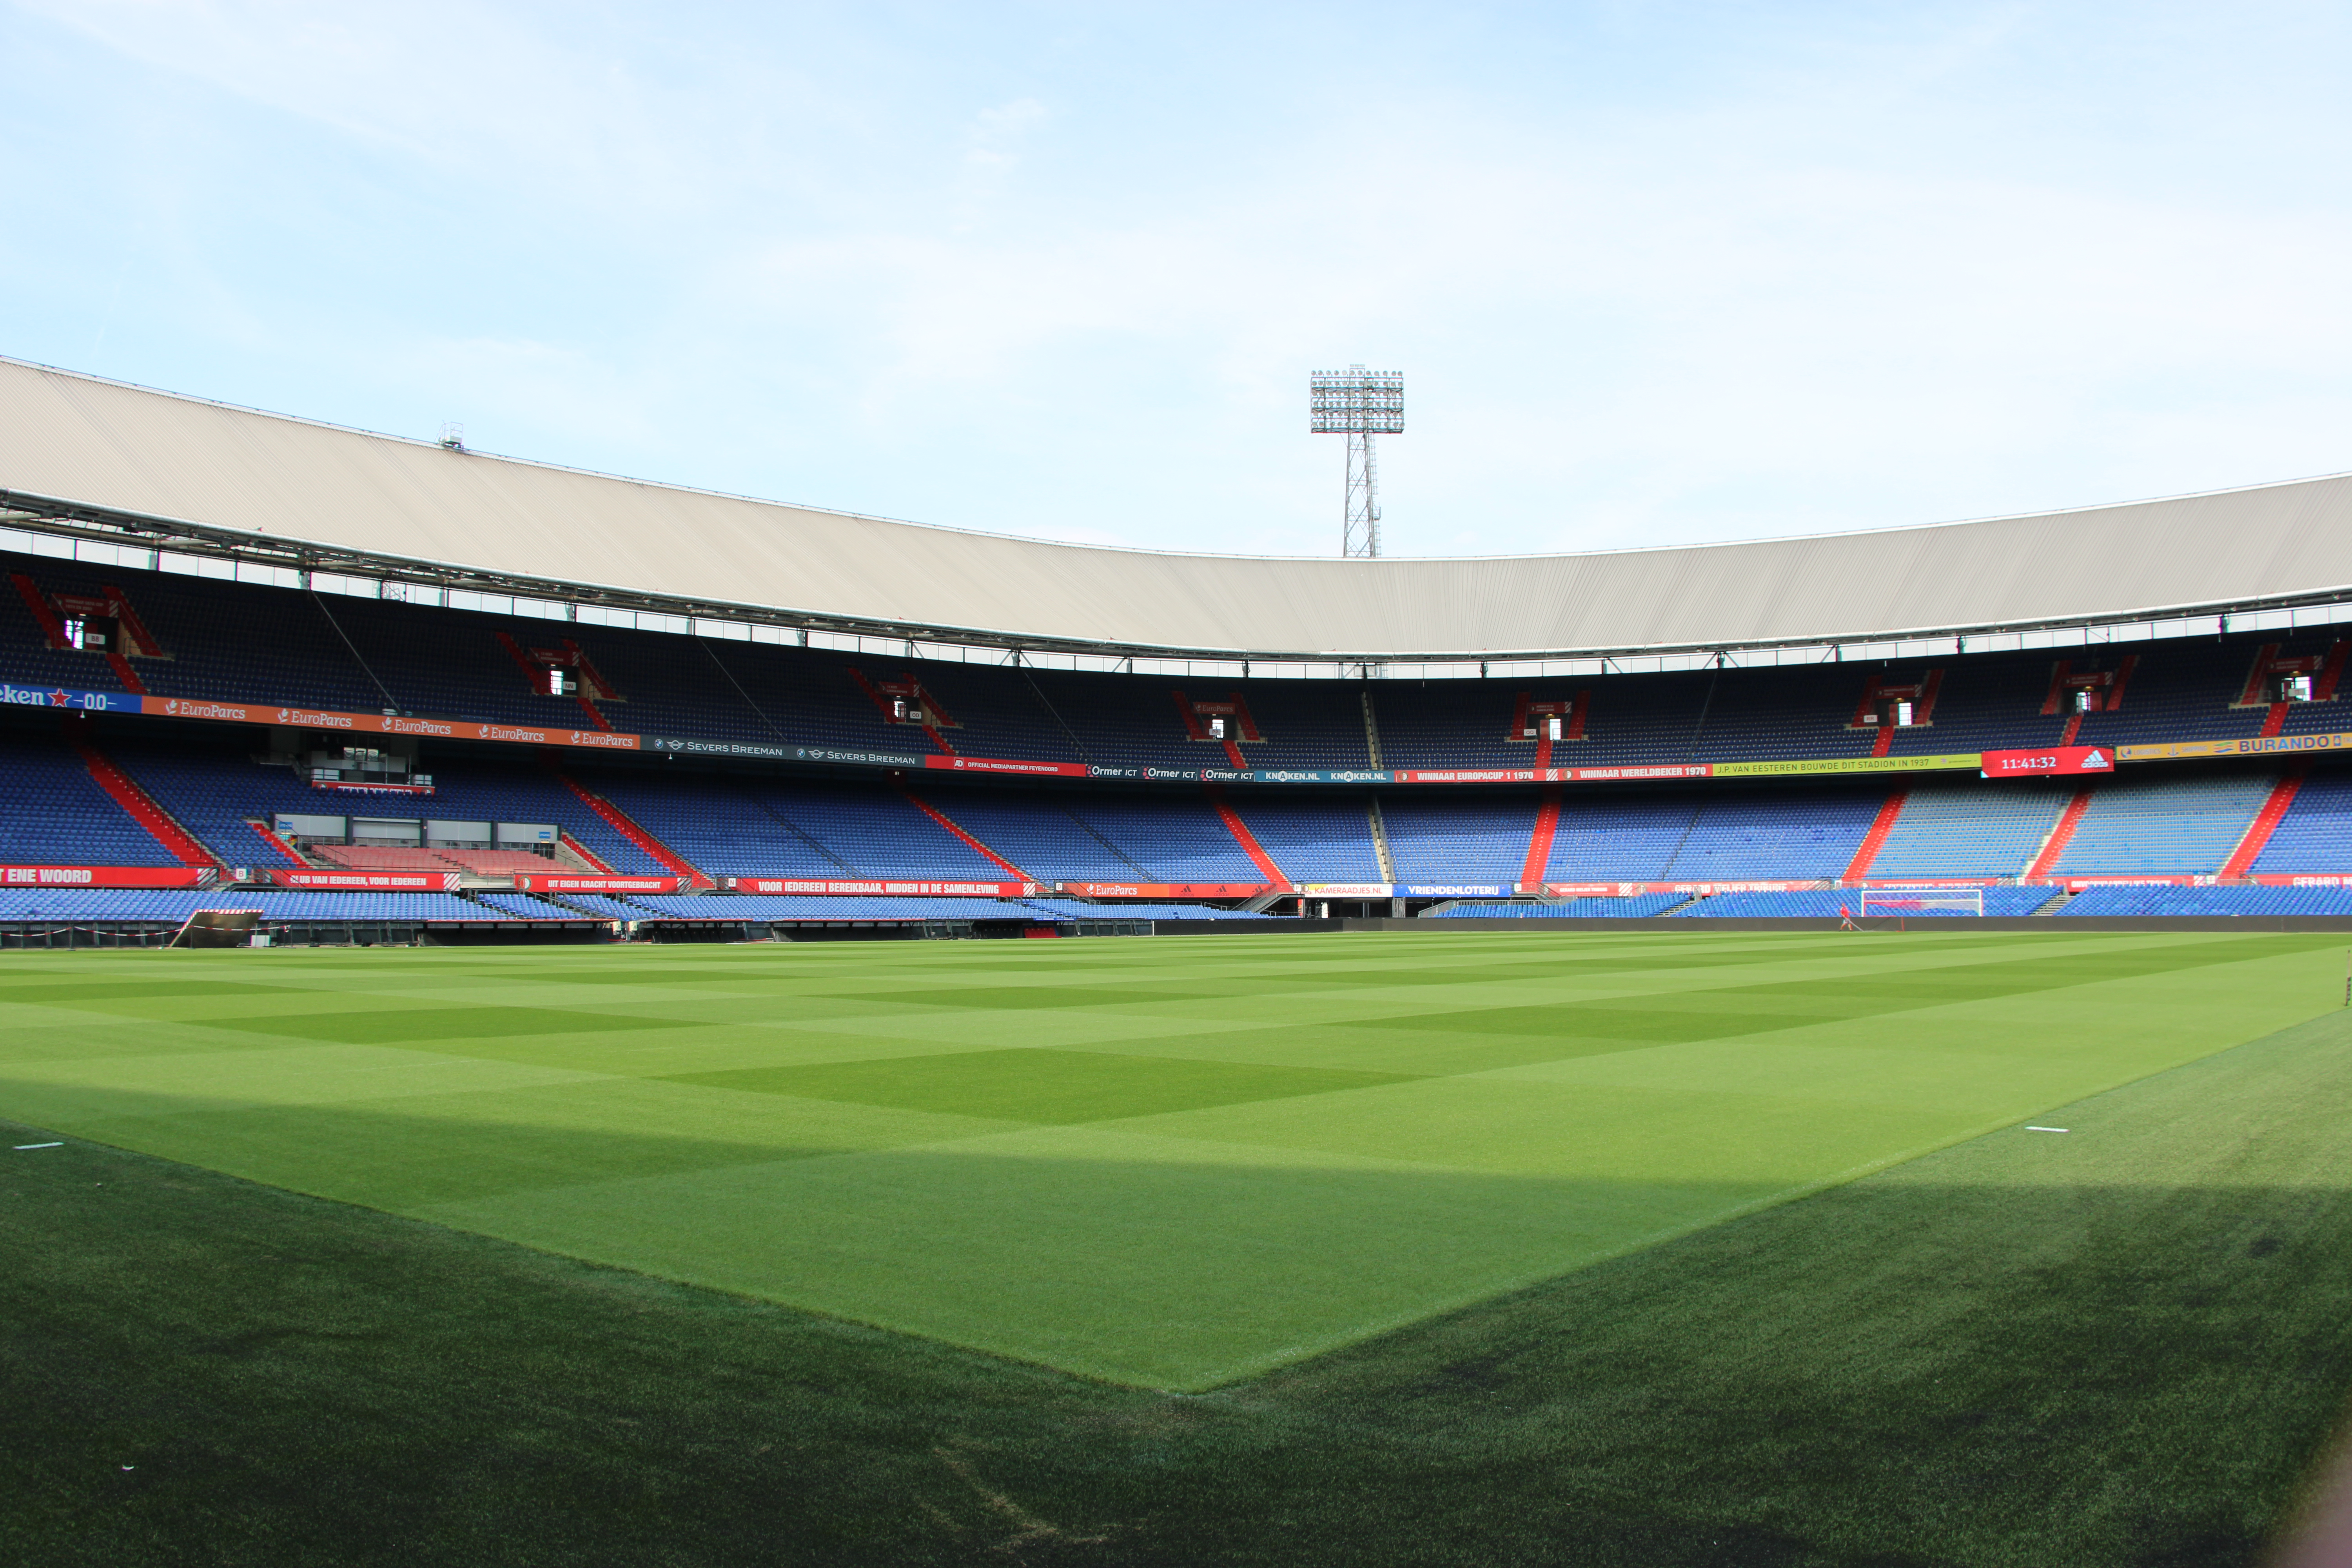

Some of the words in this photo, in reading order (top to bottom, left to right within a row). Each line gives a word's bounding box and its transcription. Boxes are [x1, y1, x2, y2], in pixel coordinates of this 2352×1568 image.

[180, 701, 245, 720] EuroParcs
[292, 711, 352, 728] EuroParcs
[394, 719, 451, 735] EuroParcs
[491, 727, 544, 742] EuroParcs
[583, 733, 633, 747] EuroParcs
[687, 742, 729, 752] SEVERS
[731, 745, 782, 756] BREEMAN
[2239, 735, 2329, 752] BURANDO
[827, 751, 866, 761] SEVERS
[869, 754, 915, 764] BREEMAN
[2002, 757, 2057, 769] 11:41:32
[1092, 766, 1122, 776] Ormer
[1801, 762, 1838, 771] BOUWDE
[1858, 760, 1896, 769] STADION
[1148, 768, 1180, 778] Ormer
[1205, 769, 1238, 779] Ormer
[1266, 771, 1320, 780] KNAKEN.NL
[1331, 771, 1387, 780] KNAKEN.NL
[1417, 772, 1455, 780] WINNAAR
[1457, 771, 1504, 780] EUROPACUP
[1513, 771, 1534, 779] 1970
[1579, 769, 1619, 778] WINNAAR
[1621, 767, 1682, 777] WERELDBEKER
[1684, 766, 1706, 776] 1970
[7, 869, 36, 882] ENE
[40, 869, 92, 883] WOORD
[290, 875, 310, 884] CLUB
[312, 876, 328, 884] VAN
[329, 876, 368, 886] IEDEREEN,
[369, 877, 389, 885] VOOR
[391, 877, 426, 886] IEDEREEN
[560, 880, 579, 888] EIGEN
[581, 880, 607, 889] KRACHT
[608, 881, 661, 889] VOORTGEBRACHT
[758, 881, 782, 892] VOOR
[784, 881, 826, 893] IEDEREEN
[828, 882, 884, 894] BEREIKBAAR,
[886, 883, 918, 893] MIDDEN
[920, 883, 929, 893] IN
[931, 884, 942, 894] DE
[943, 884, 999, 894] SAMENLEVING
[1096, 885, 1138, 895] EuroParcs
[1408, 886, 1499, 895] VRIENDENLOTERIJ
